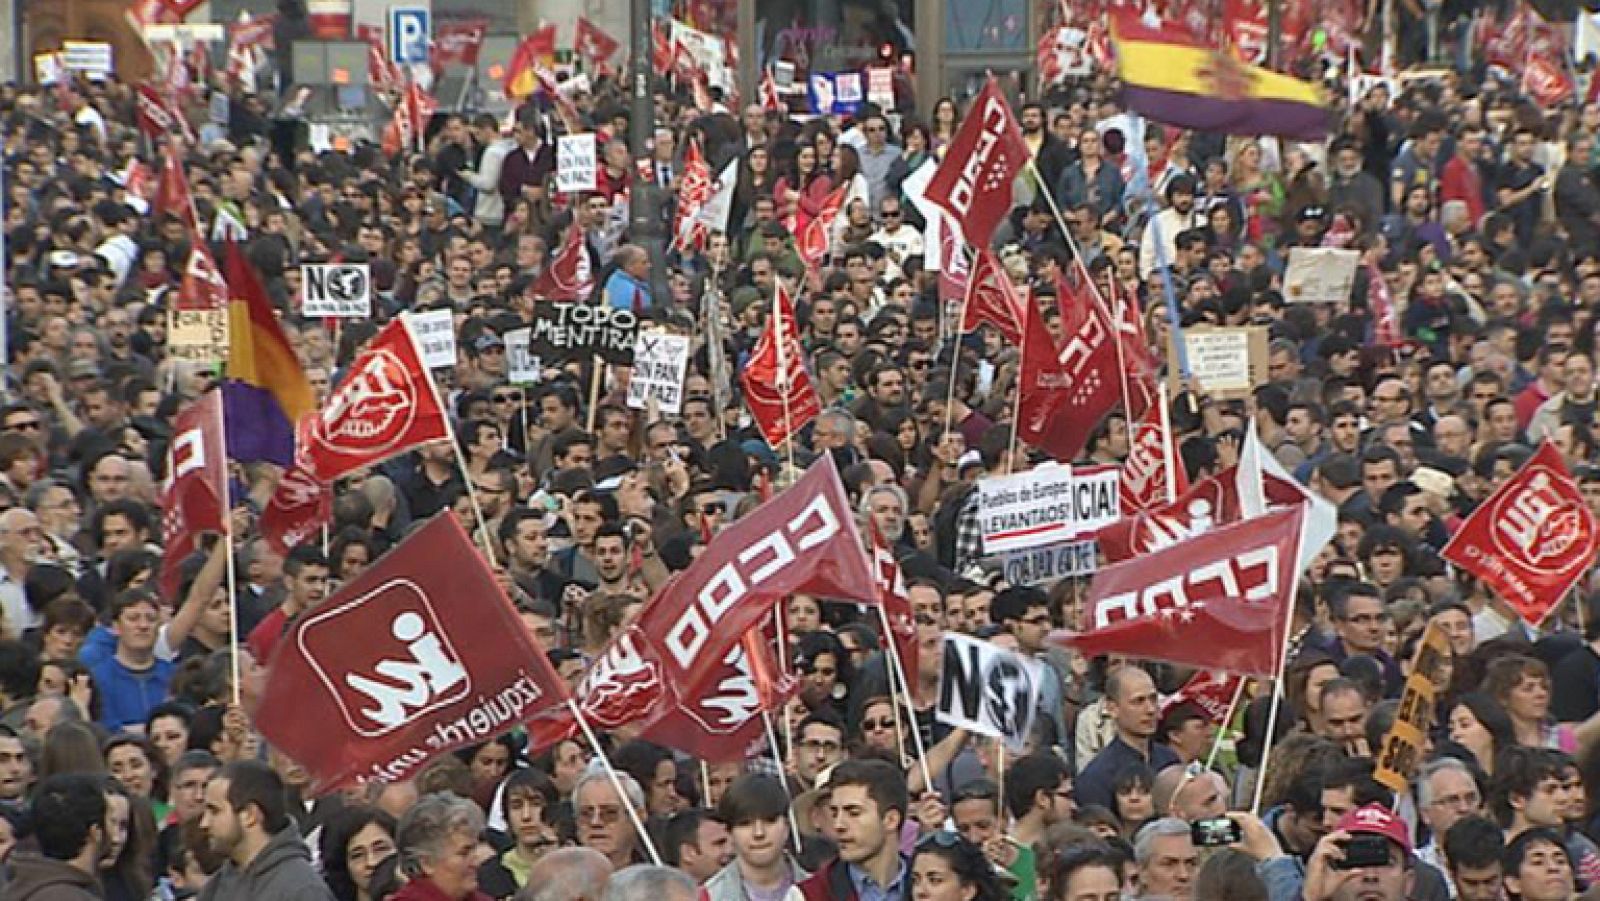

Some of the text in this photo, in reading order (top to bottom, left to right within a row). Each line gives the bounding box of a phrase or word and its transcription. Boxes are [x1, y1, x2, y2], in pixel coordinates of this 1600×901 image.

[399, 13, 420, 58] P
[532, 316, 636, 350] MENTIRA
[552, 302, 637, 329] TODO
[1497, 472, 1566, 549] UGT
